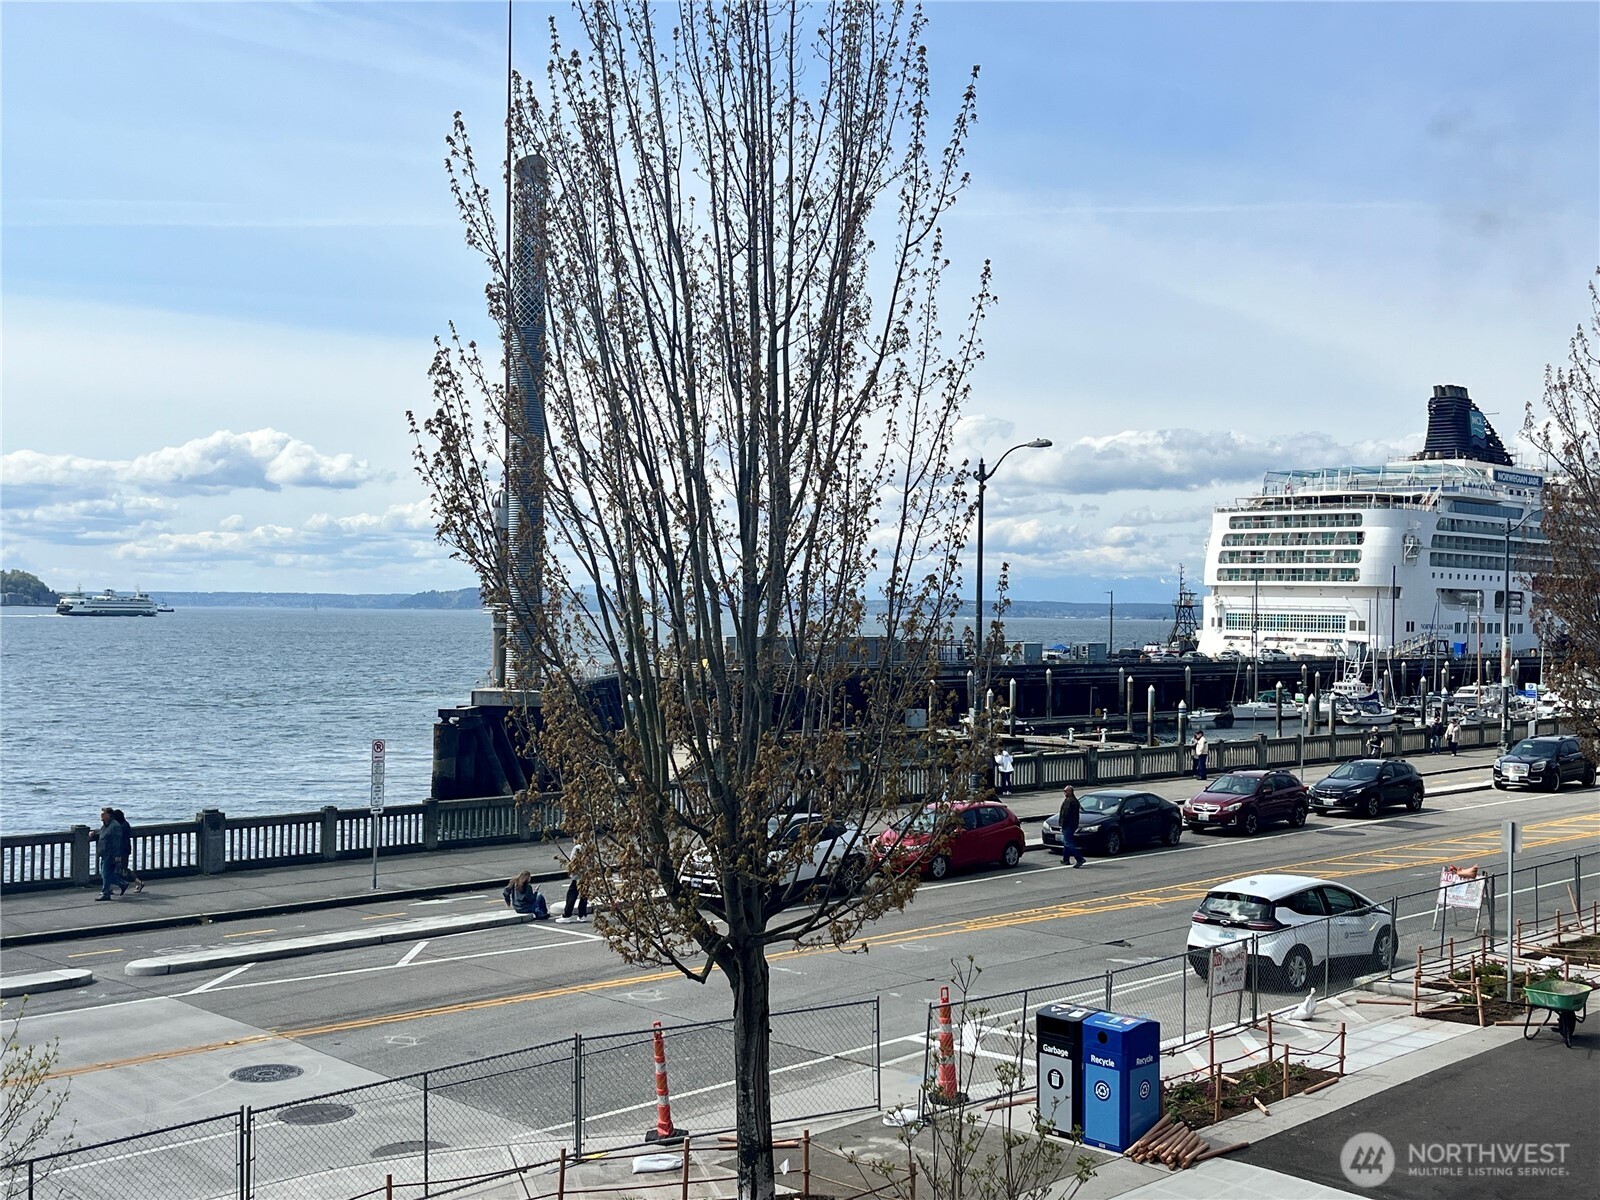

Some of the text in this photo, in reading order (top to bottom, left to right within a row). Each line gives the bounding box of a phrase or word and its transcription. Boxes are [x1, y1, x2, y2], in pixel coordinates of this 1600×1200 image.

[1497, 472, 1539, 486] NORWEGIAN JADE
[1042, 1043, 1069, 1057] Garbage
[1090, 1054, 1115, 1068] Recycle
[1136, 1054, 1154, 1066] Recycle
